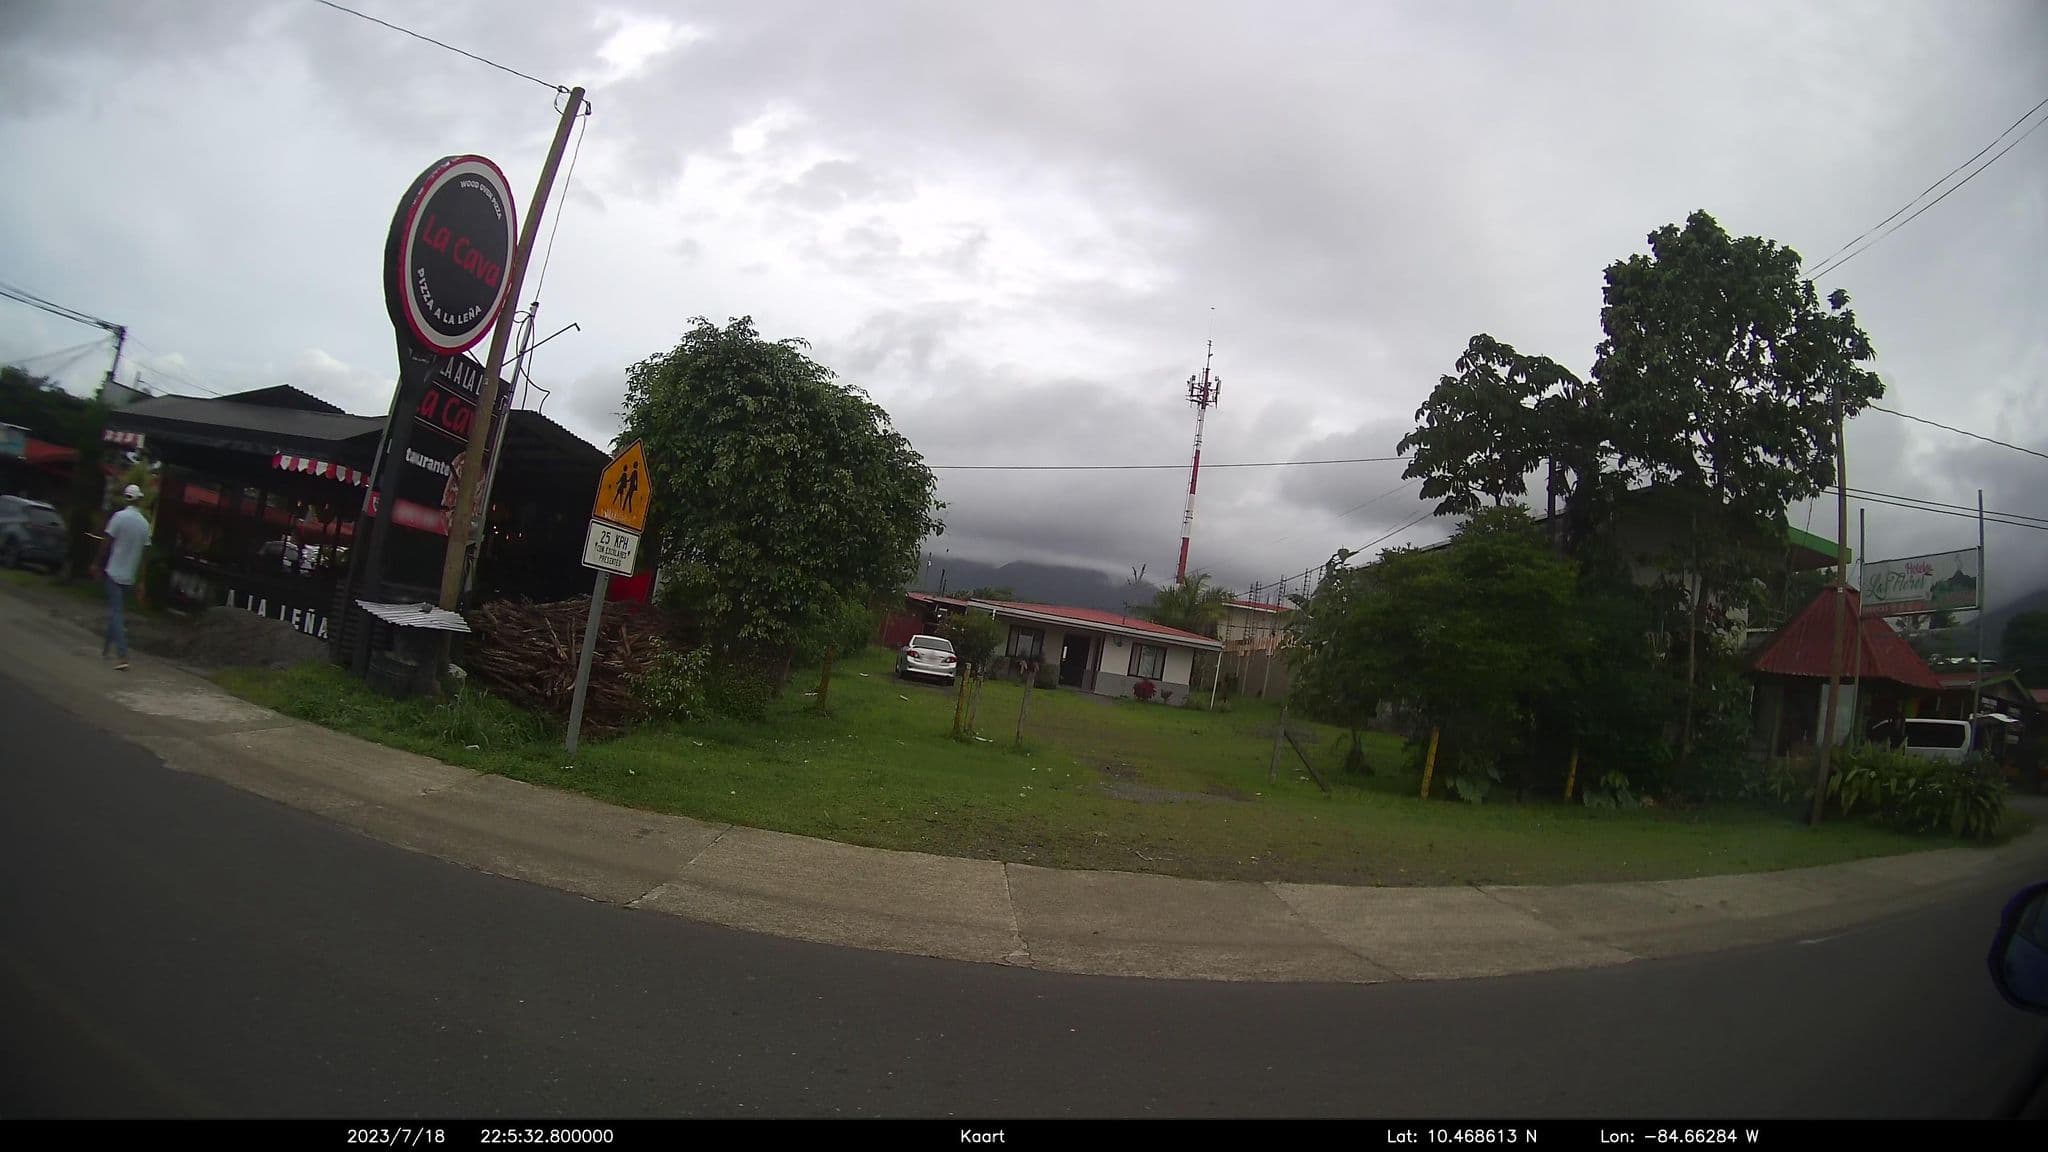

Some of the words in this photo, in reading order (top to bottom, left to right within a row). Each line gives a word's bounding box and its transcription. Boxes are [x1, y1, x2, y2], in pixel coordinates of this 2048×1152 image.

[460, 180, 480, 189] WOOD
[422, 213, 452, 256] La
[452, 236, 502, 288] Cava
[417, 267, 434, 311] PIZZA
[434, 307, 442, 320] A
[443, 312, 455, 325] LA
[457, 305, 482, 324] LEÑA
[405, 447, 451, 477] taurante
[600, 530, 611, 544] 25
[614, 535, 629, 550] KPH
